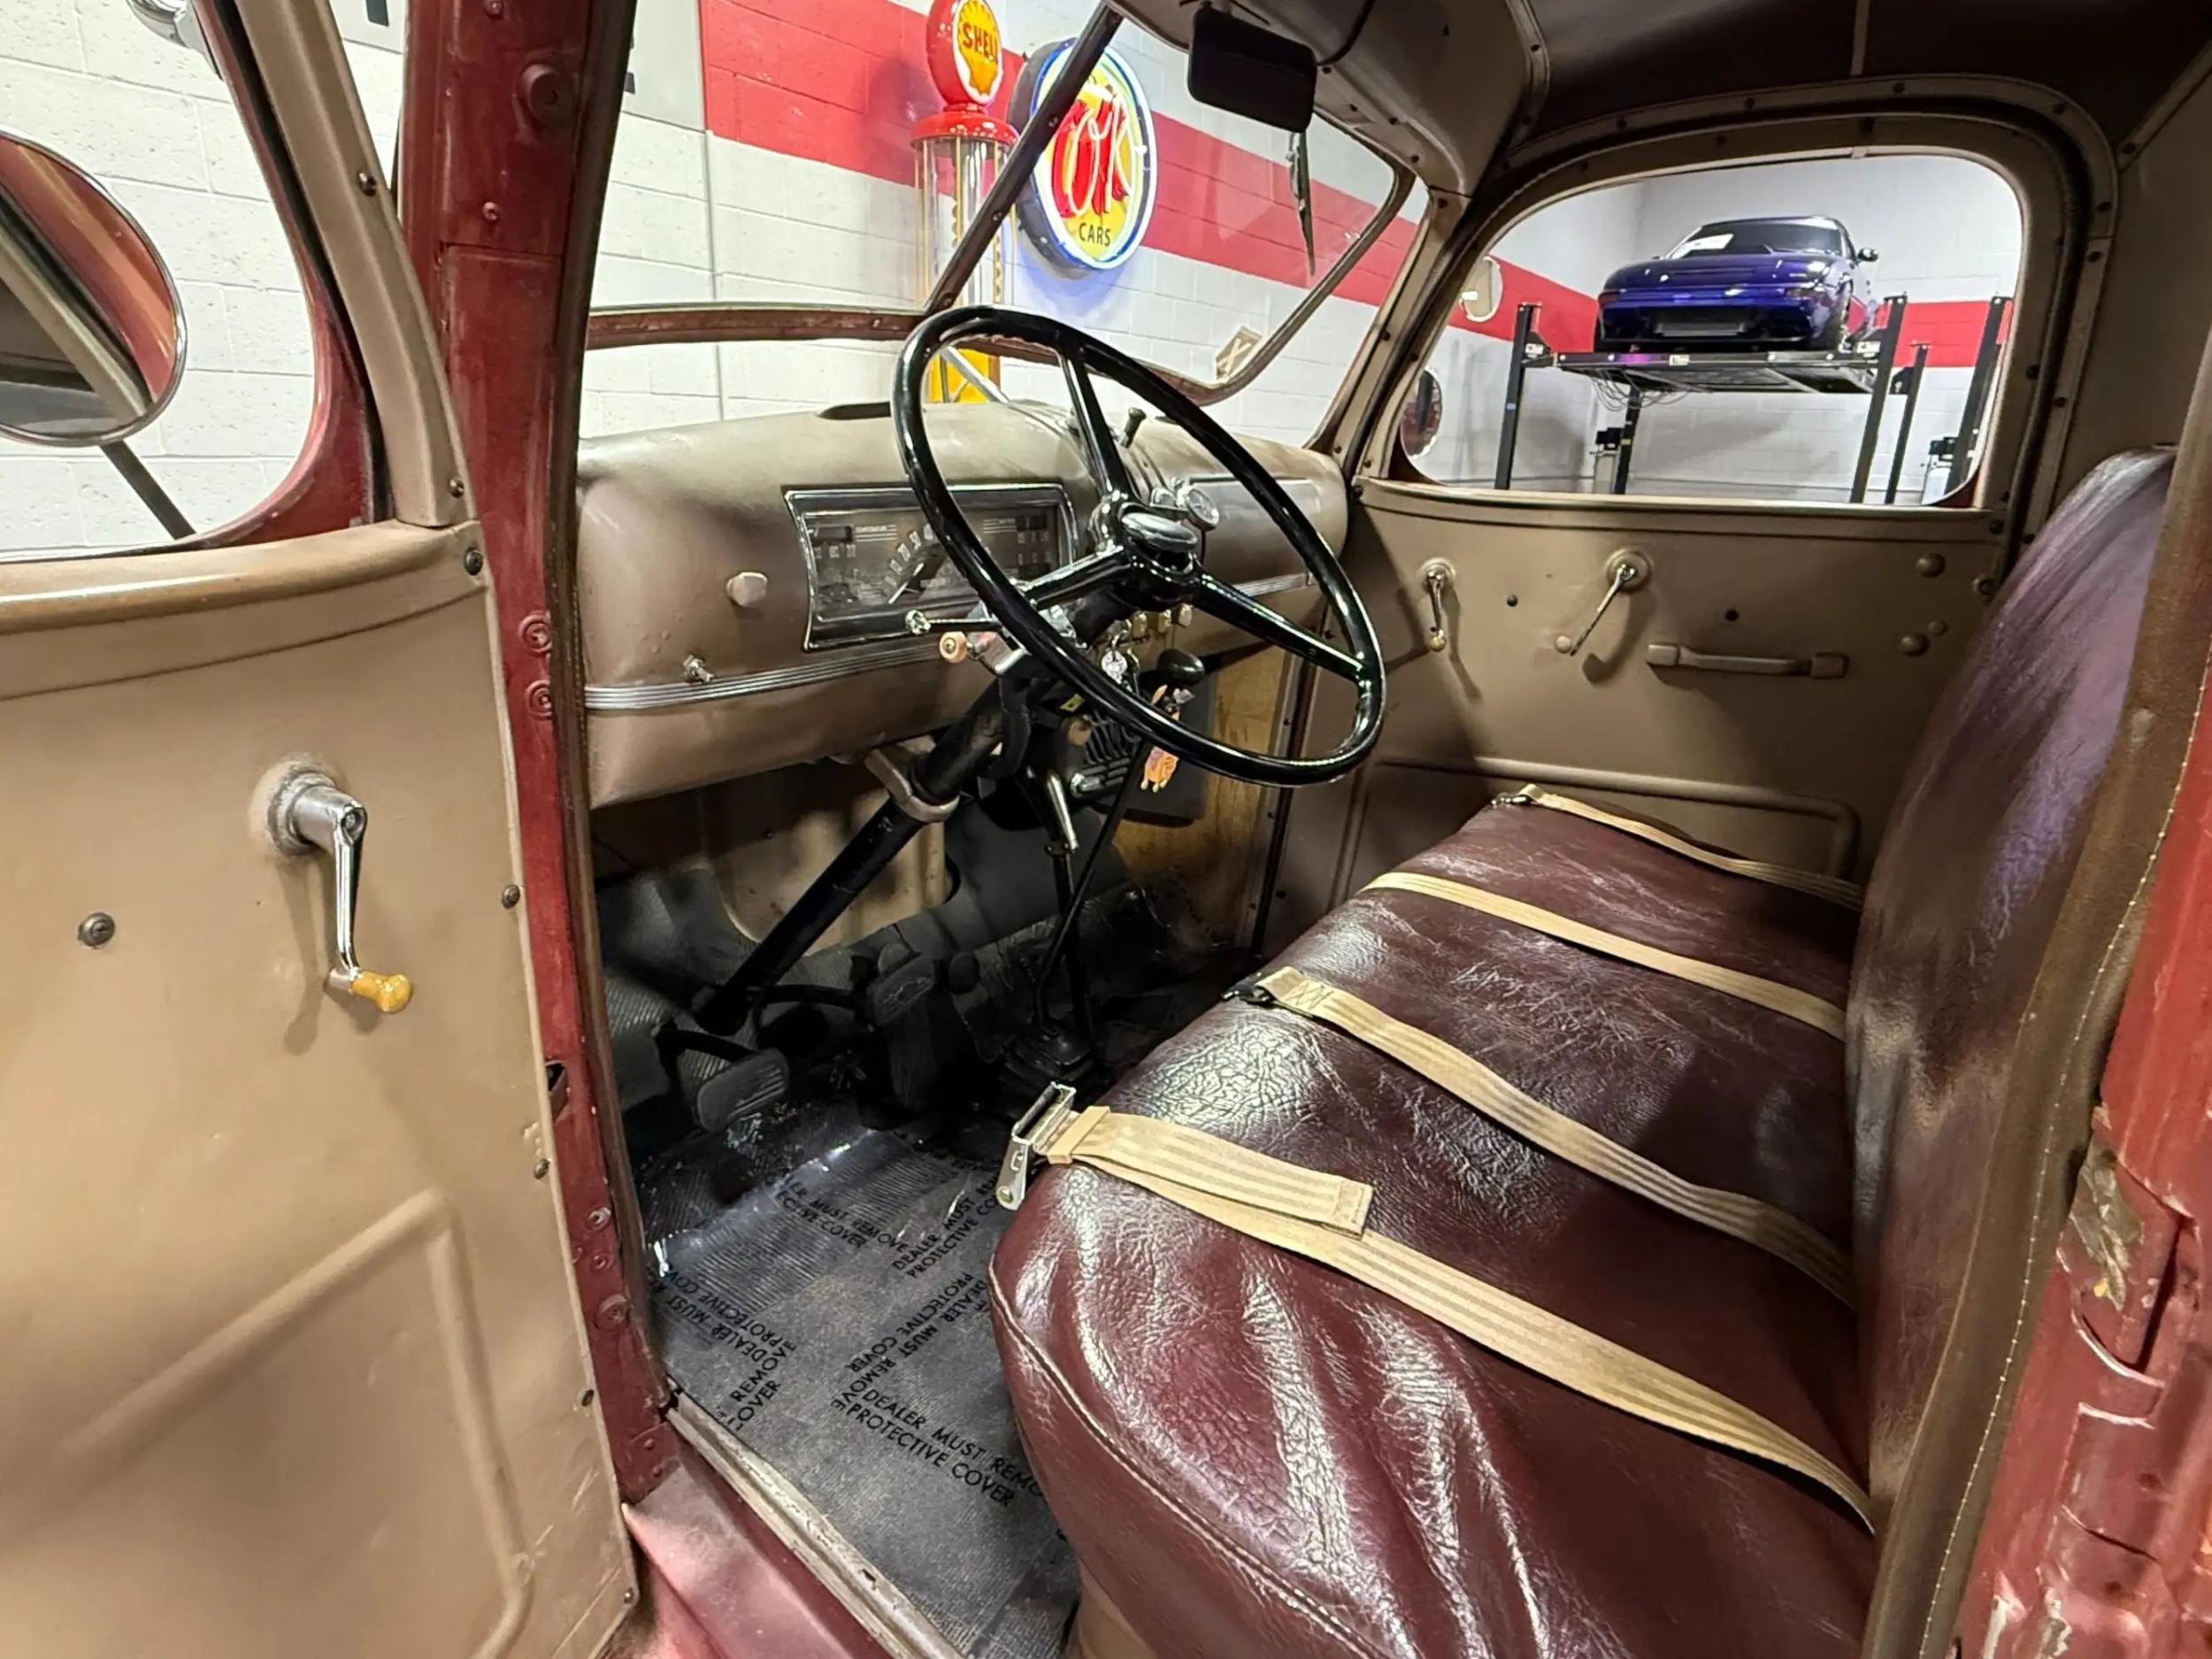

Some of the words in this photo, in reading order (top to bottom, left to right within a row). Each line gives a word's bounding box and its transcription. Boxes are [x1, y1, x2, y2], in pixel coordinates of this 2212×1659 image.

[1051, 97, 1132, 218] OK
[1079, 222, 1110, 247] CARS
[809, 1199, 850, 1220] MUST
[851, 1217, 909, 1253] REMOVE
[820, 1220, 867, 1248] COVER
[892, 1233, 941, 1271] DEALER
[942, 1197, 976, 1231] MUST
[906, 1217, 979, 1279] PROTECTIVE
[666, 1294, 710, 1325] MUST
[699, 1292, 784, 1348] PROTECTIVE
[895, 1271, 974, 1336] PROTECTIVE
[940, 1279, 987, 1323] DEALER
[711, 1322, 768, 1363] DEALER
[845, 1336, 898, 1372] COVER
[898, 1325, 939, 1358] MUST
[730, 1340, 798, 1402] REMOVE
[831, 1357, 897, 1411] REMOVE
[846, 1402, 950, 1468] PROTECTIVE
[952, 1462, 1016, 1507] COVER
[862, 1388, 927, 1430] DEALER
[932, 1426, 987, 1460] MUST
[990, 1456, 1043, 1497] REMO
